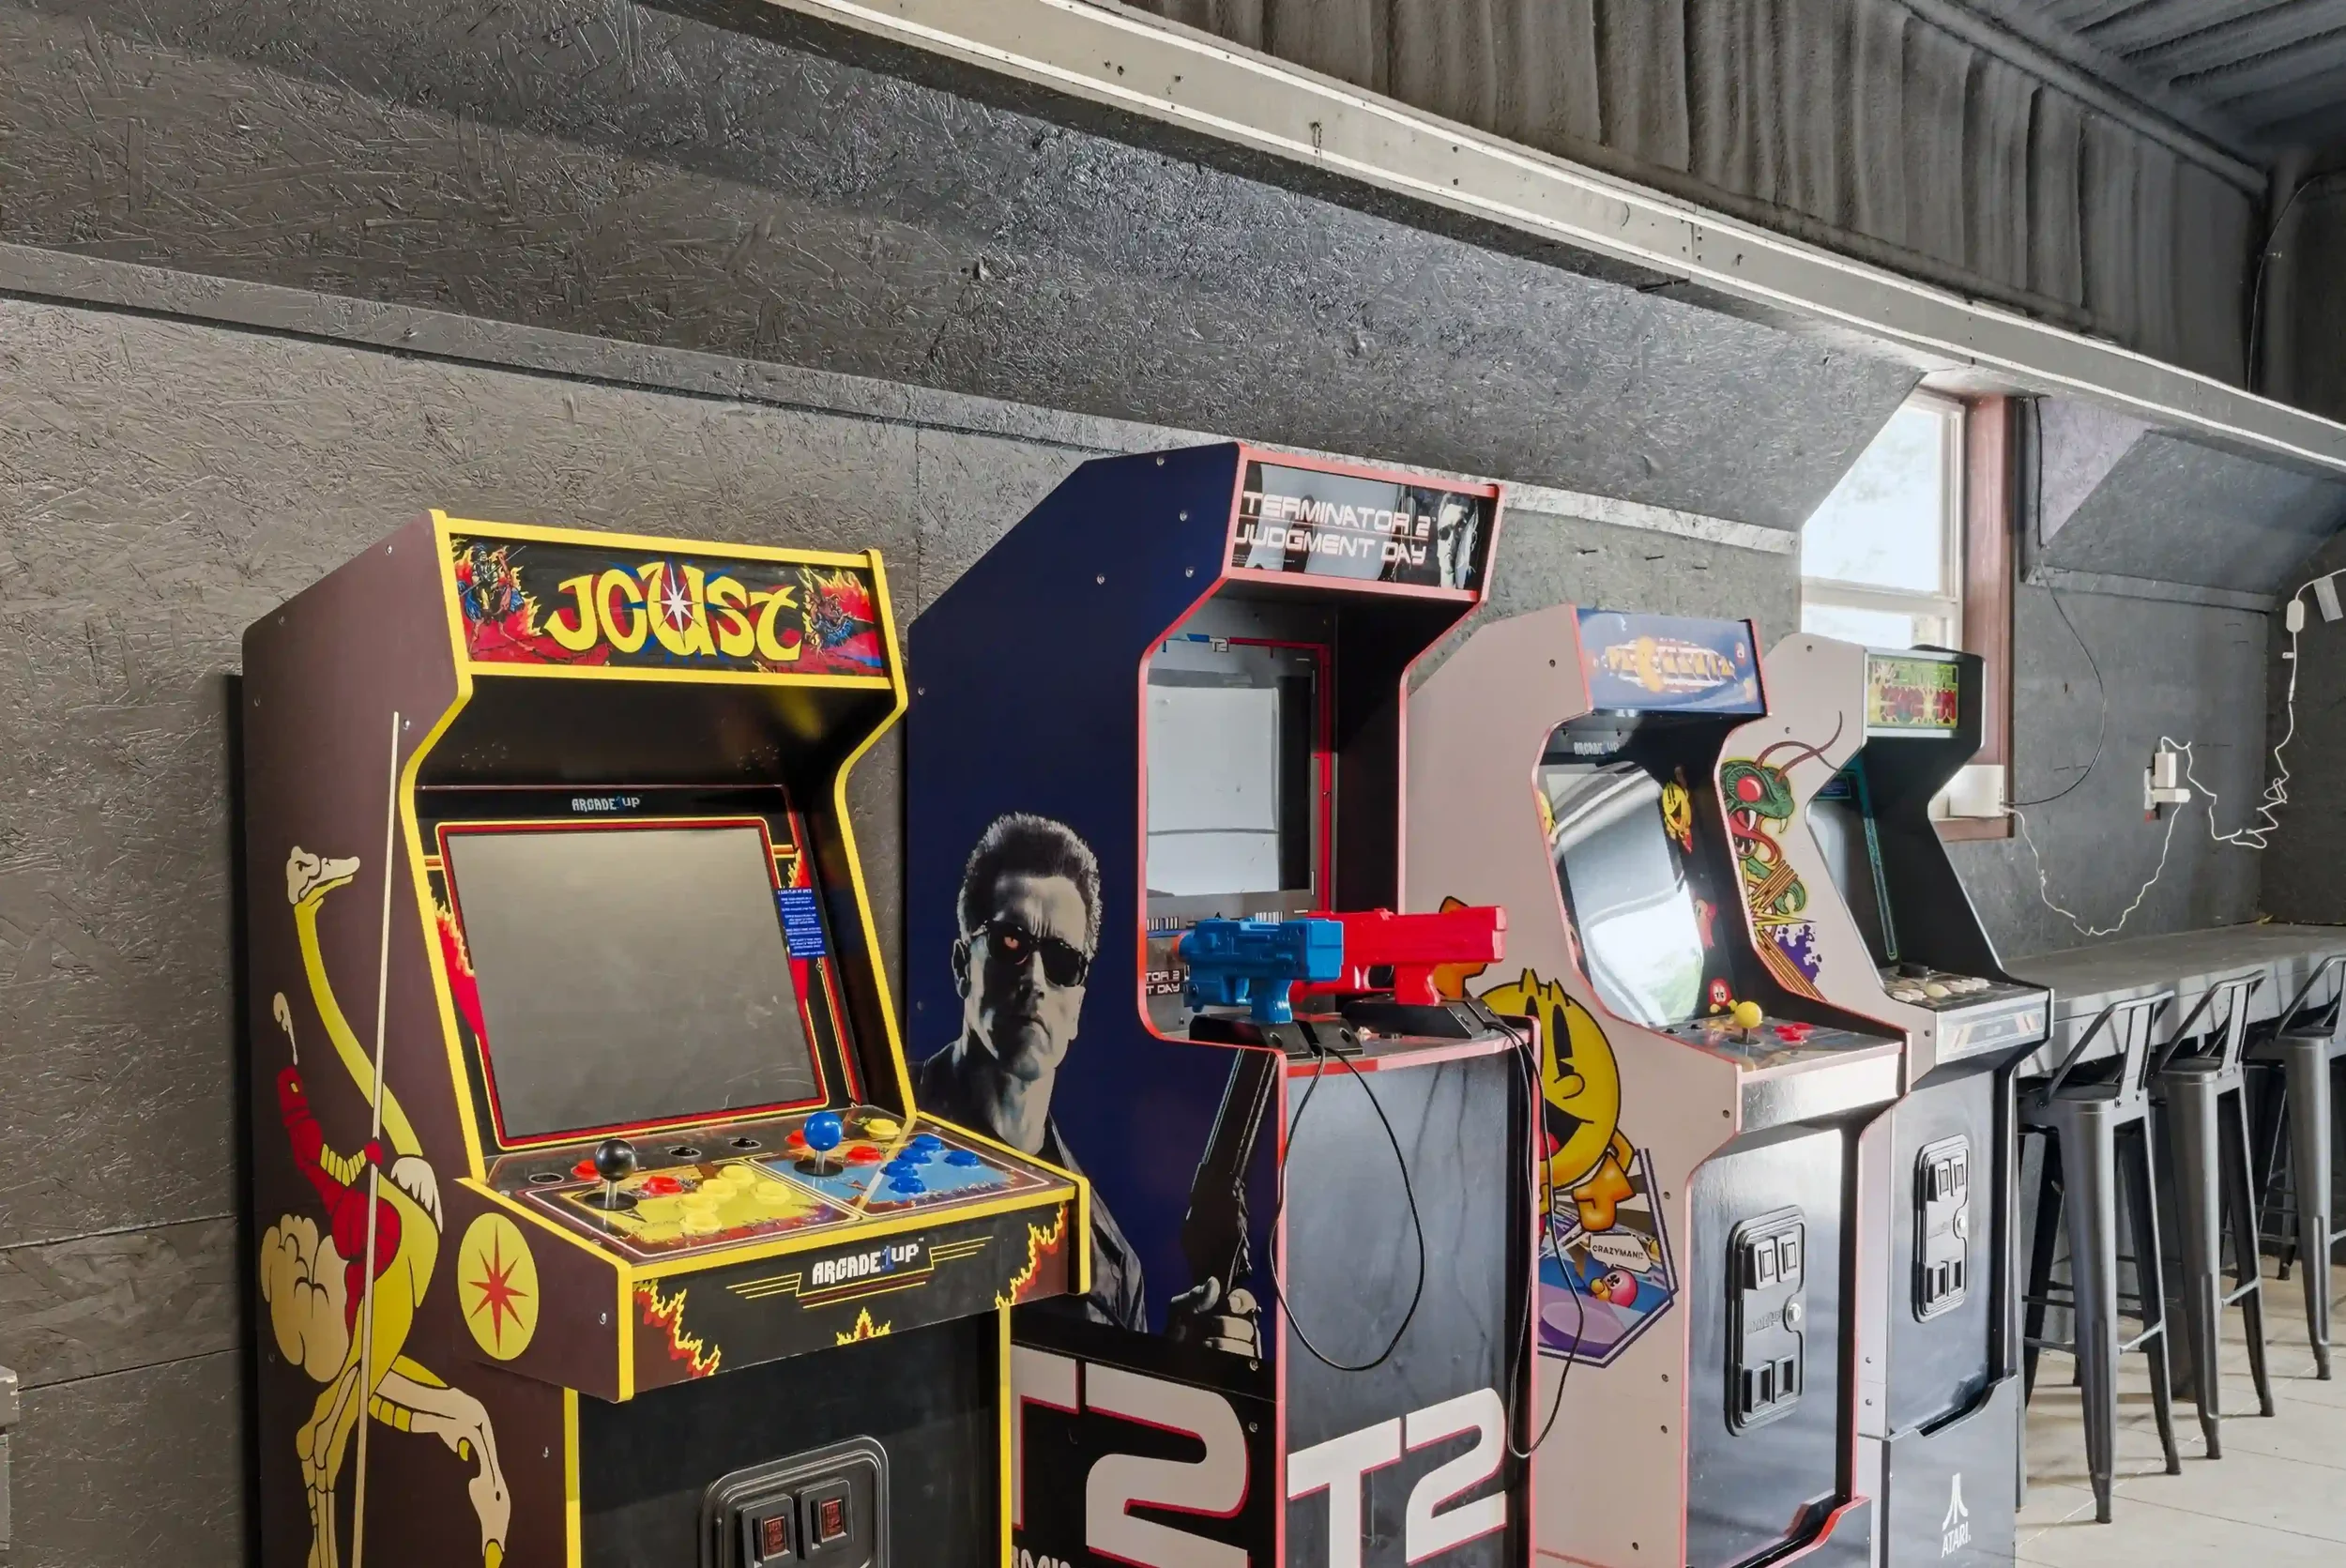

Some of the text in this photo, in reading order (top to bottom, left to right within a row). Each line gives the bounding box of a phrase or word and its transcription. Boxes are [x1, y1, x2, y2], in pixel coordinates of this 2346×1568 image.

[1243, 491, 1431, 537] TERMINATOR 2
[1234, 524, 1427, 565] JUDGMENT DAY
[812, 1242, 920, 1286] ARCADE1UP
[1287, 1387, 1507, 1568] T2
[1941, 1521, 1969, 1559] ATARI
